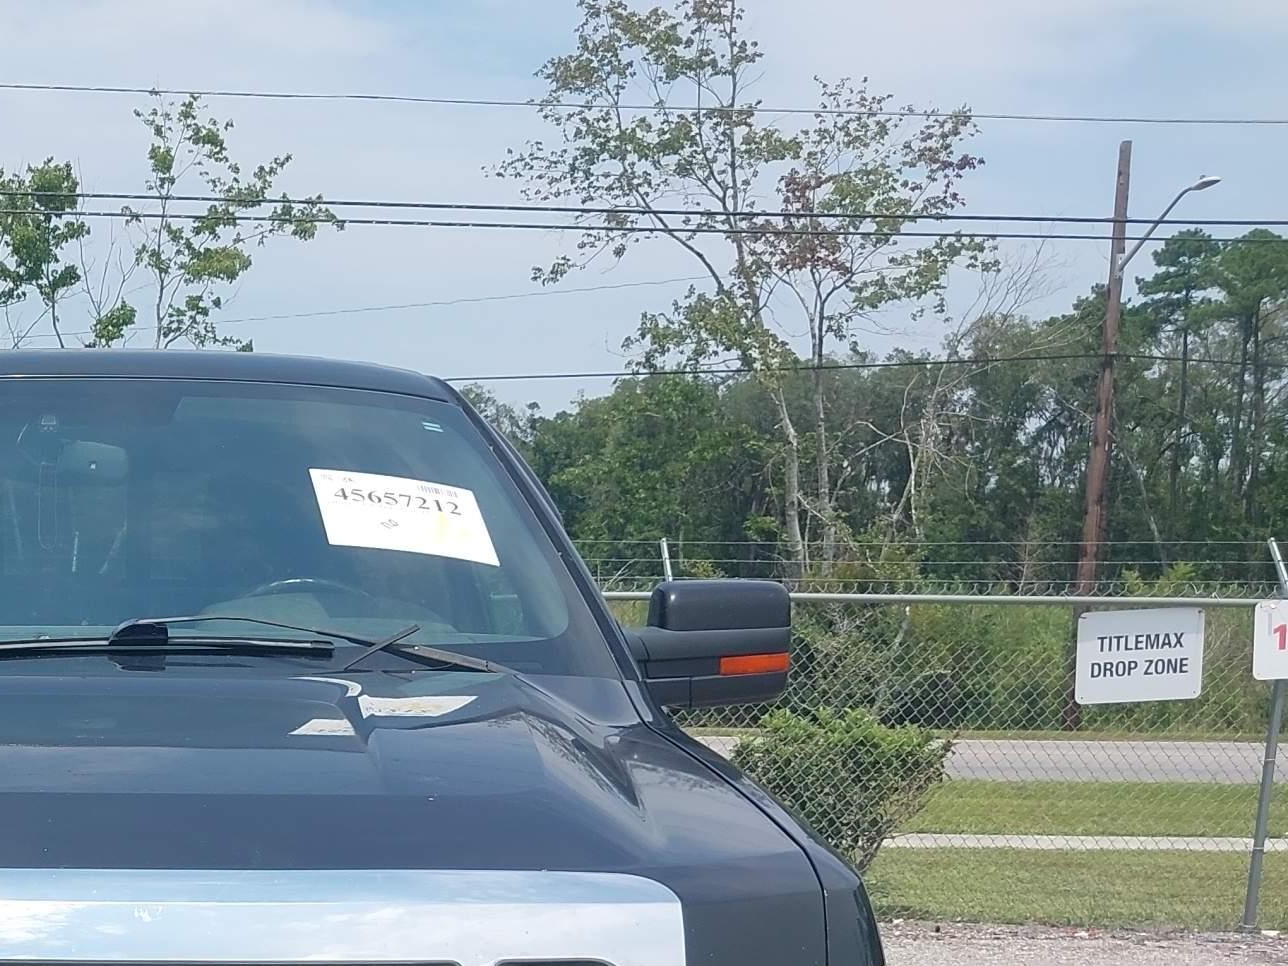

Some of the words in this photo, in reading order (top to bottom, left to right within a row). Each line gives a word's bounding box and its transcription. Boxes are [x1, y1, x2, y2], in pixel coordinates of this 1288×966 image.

[333, 486, 462, 516] 45657212
[1096, 632, 1185, 653] TITLEMAX
[1090, 660, 1138, 679] DROP
[1143, 657, 1189, 676] ZONE
